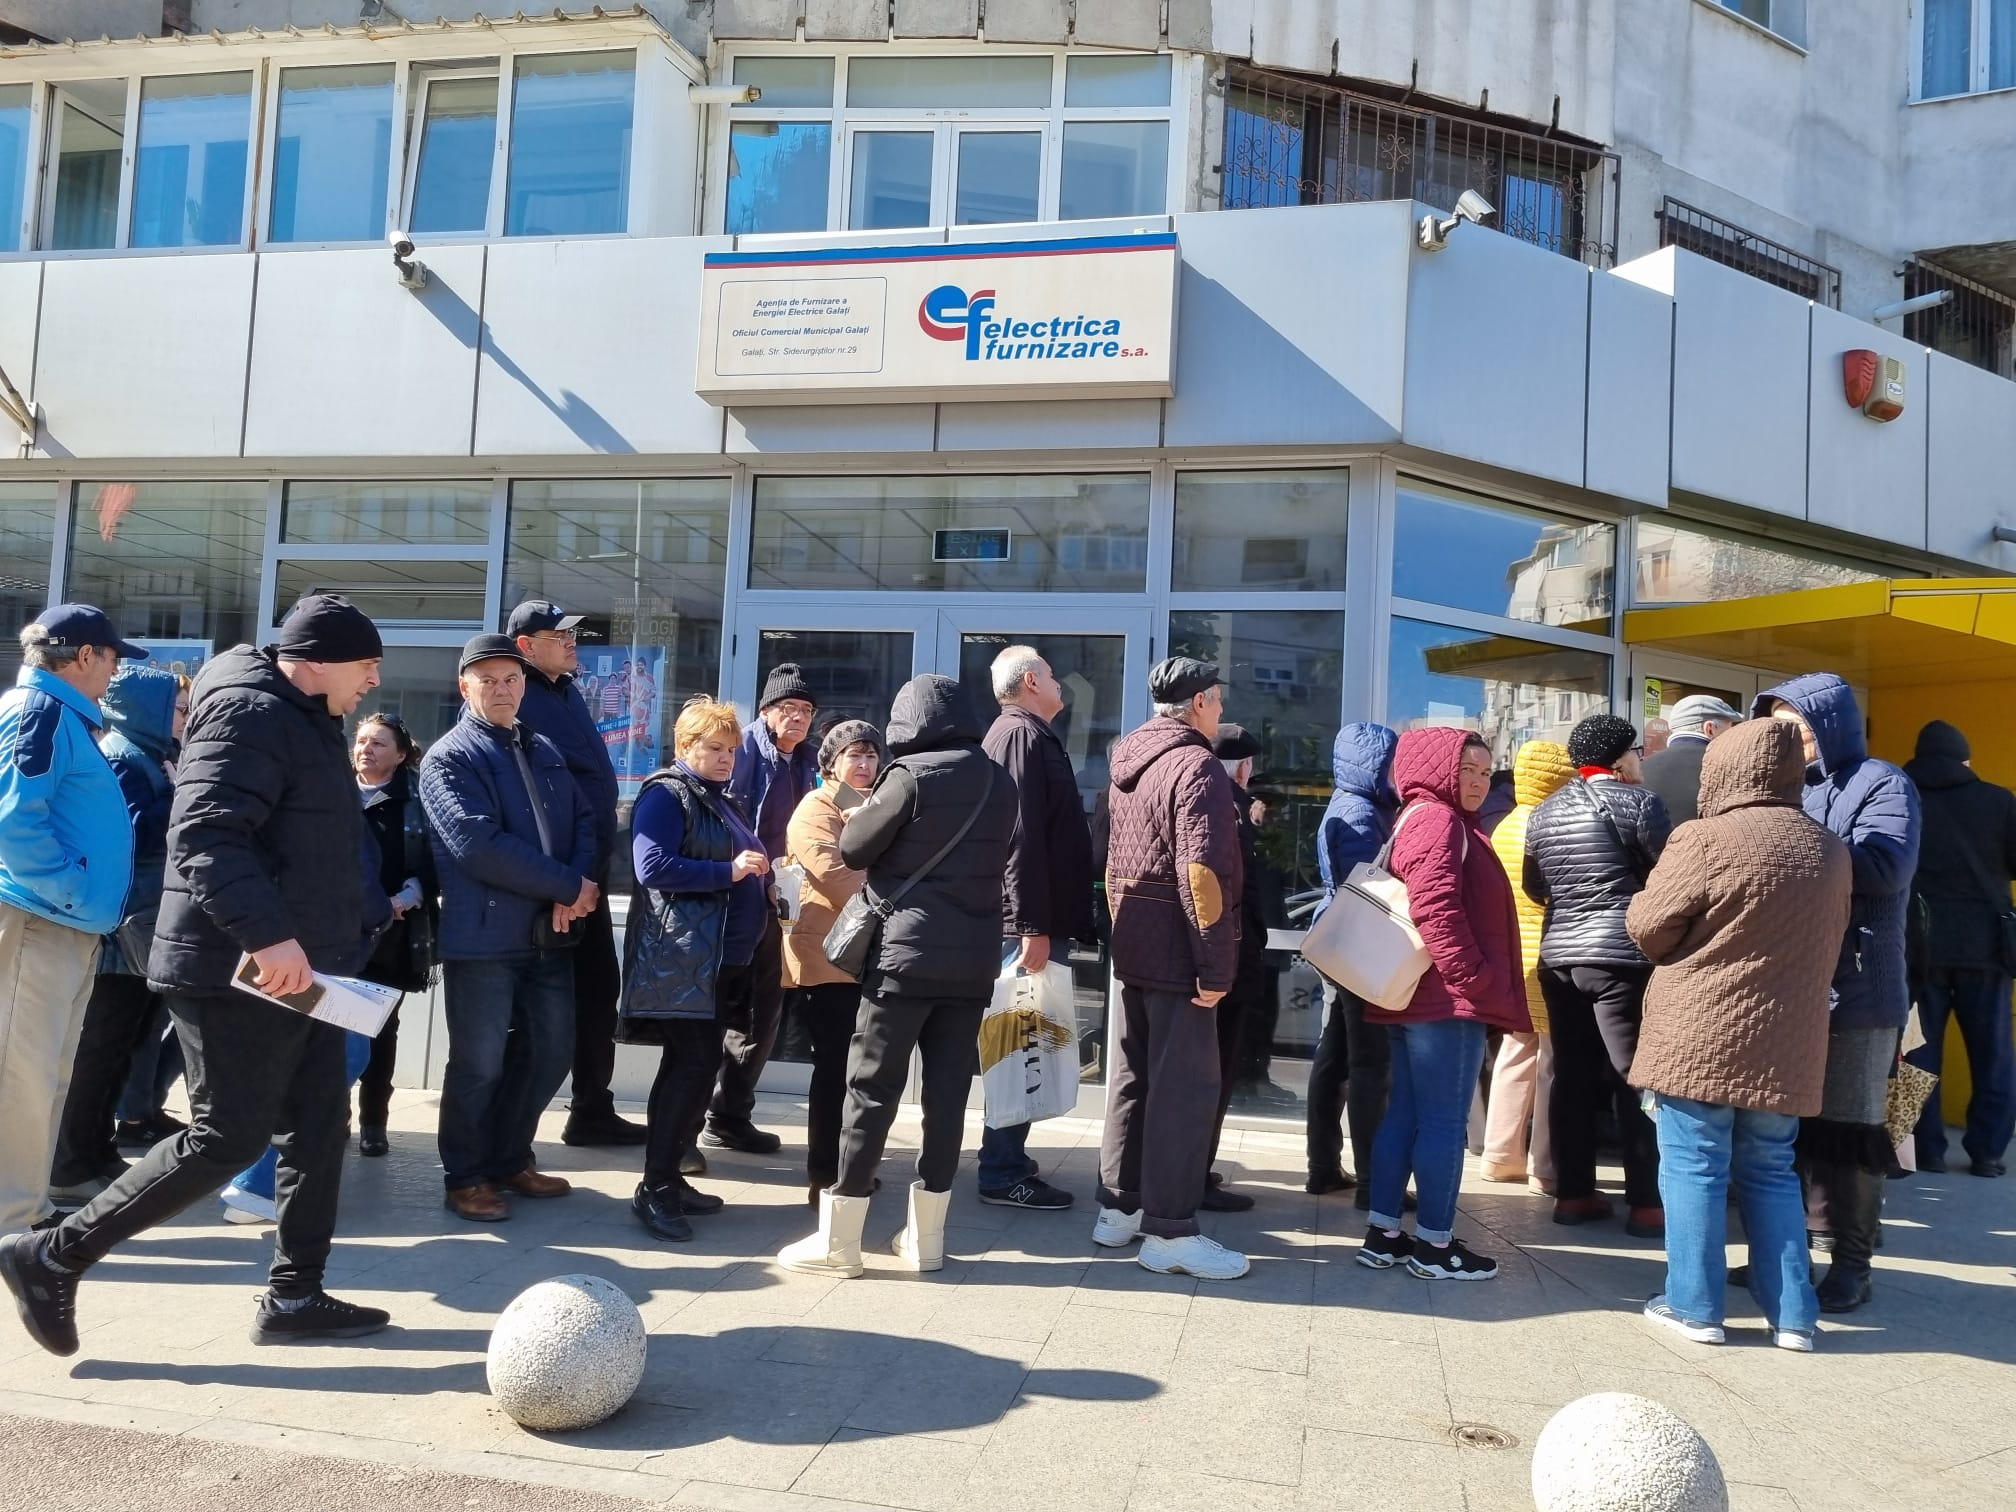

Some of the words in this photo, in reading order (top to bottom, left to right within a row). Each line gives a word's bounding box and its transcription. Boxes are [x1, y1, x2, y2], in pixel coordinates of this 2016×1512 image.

[789, 298, 800, 306] de
[752, 309, 786, 318] Energiei
[788, 308, 824, 316] Electrice
[732, 329, 759, 337] Oficiul
[760, 328, 802, 336] Comercial
[803, 326, 844, 336] Municipal
[984, 315, 1121, 339] electrica
[985, 338, 1119, 361] furnizare
[1120, 346, 1149, 358] s.a.
[604, 731, 627, 743] LUMEA
